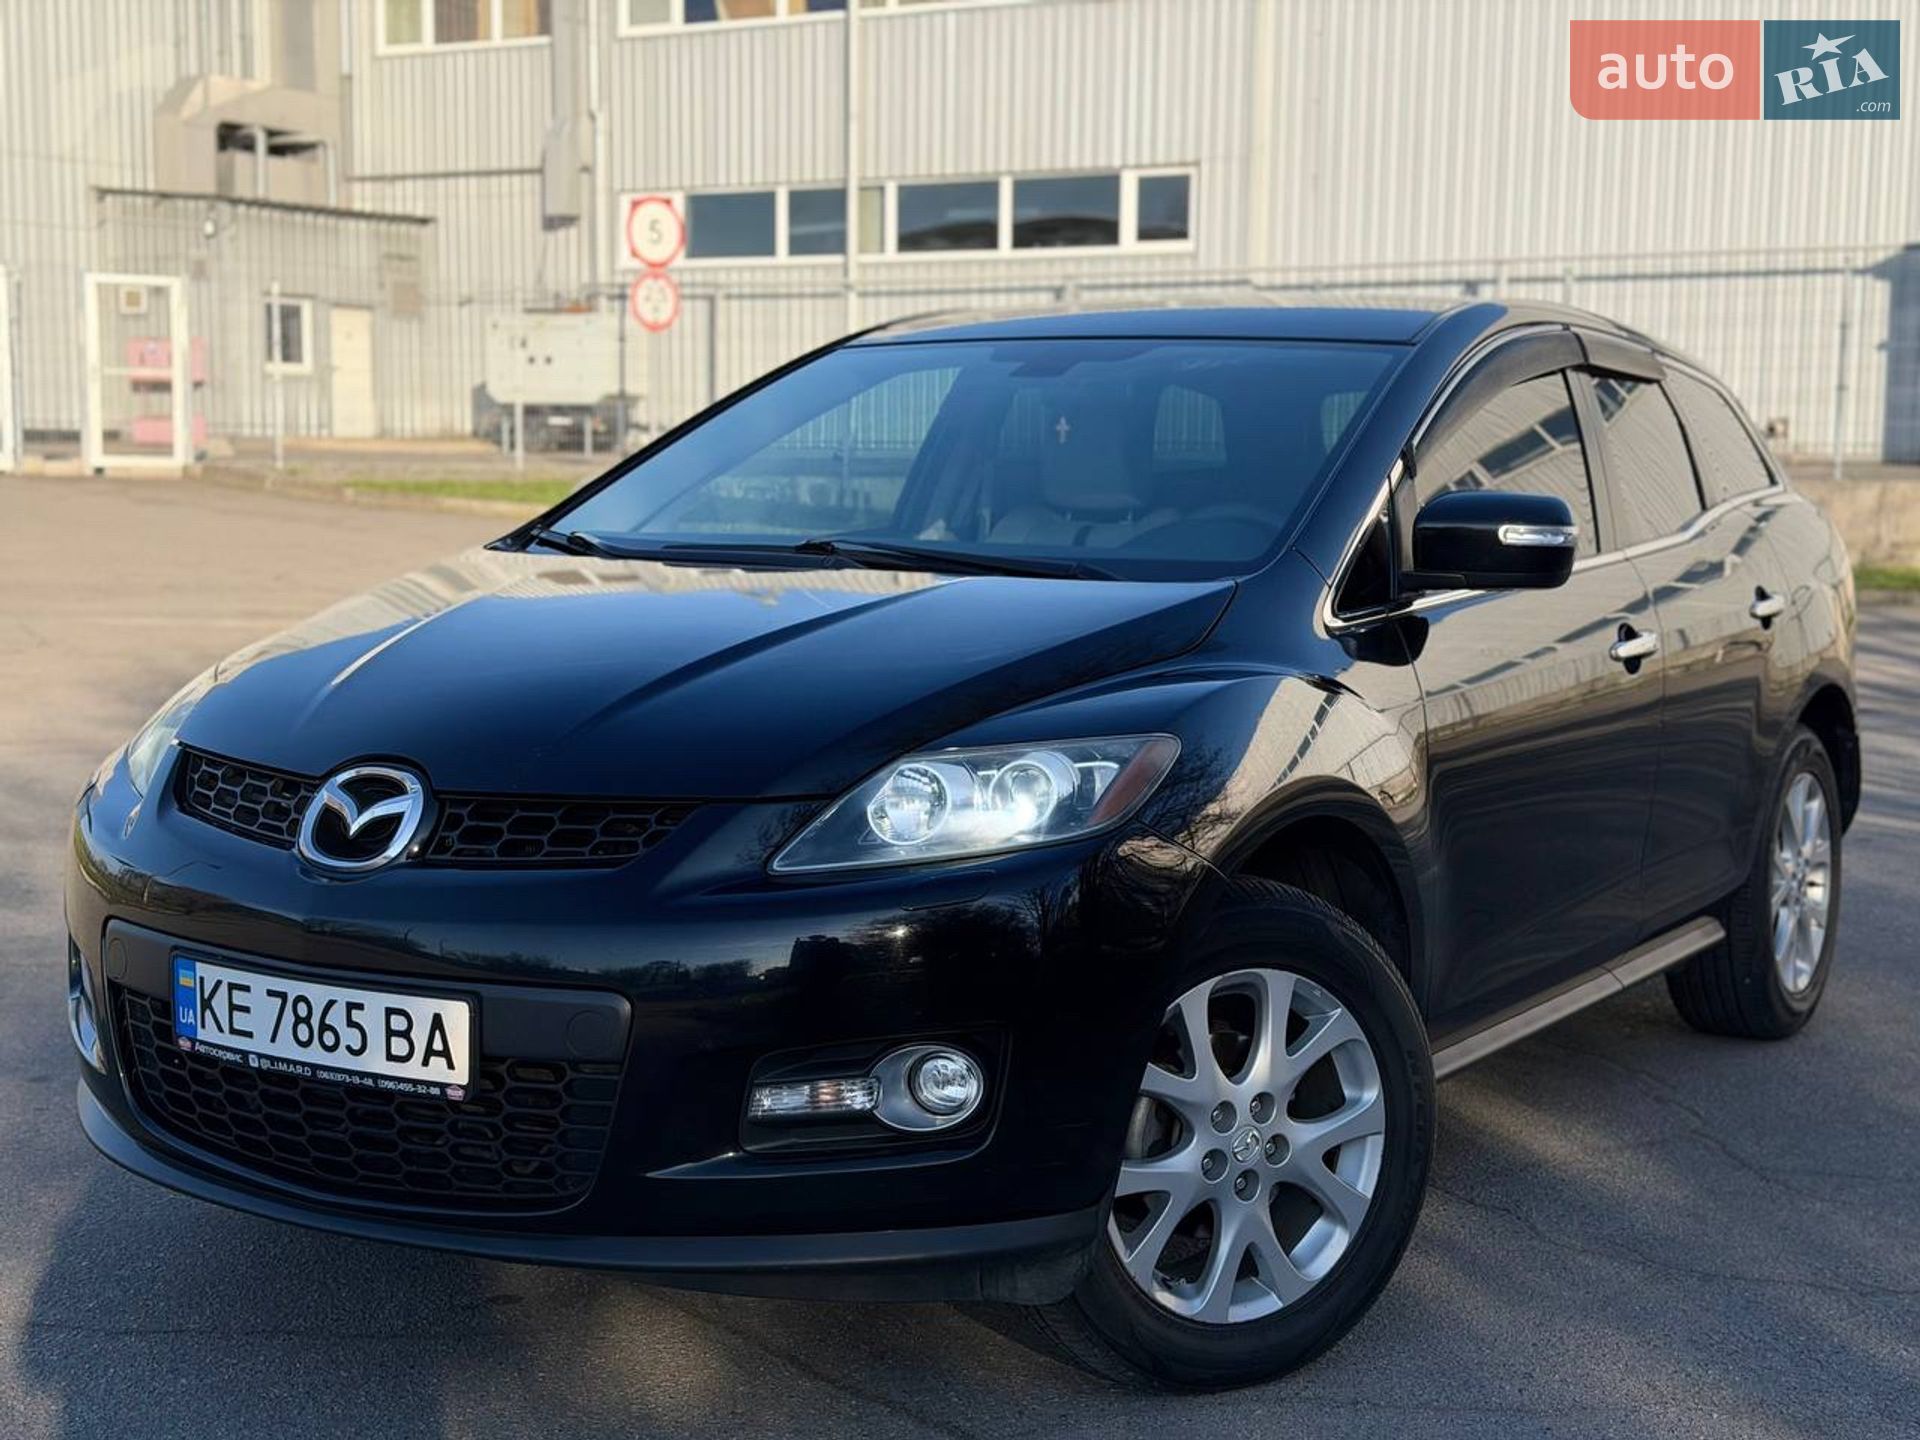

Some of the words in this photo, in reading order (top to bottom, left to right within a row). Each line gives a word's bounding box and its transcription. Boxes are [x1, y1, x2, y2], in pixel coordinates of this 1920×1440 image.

[648, 218, 664, 245] 5
[179, 1005, 196, 1026] UA
[199, 976, 254, 1039] KE
[266, 988, 368, 1057] 7865
[384, 1006, 456, 1071] BA
